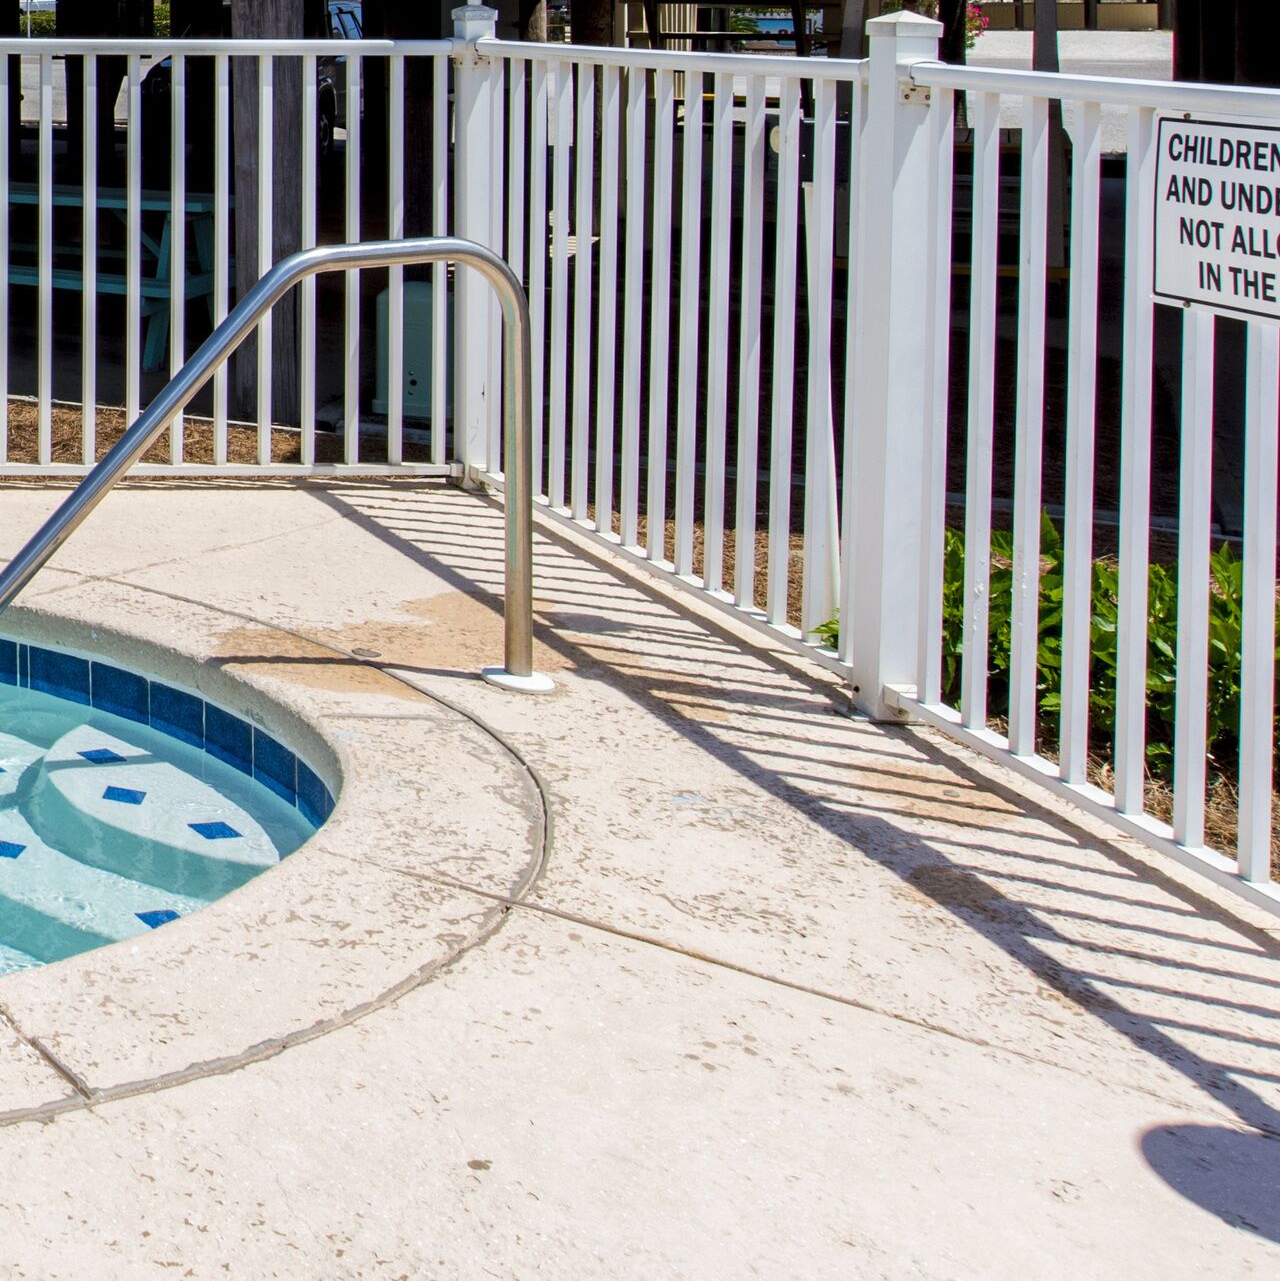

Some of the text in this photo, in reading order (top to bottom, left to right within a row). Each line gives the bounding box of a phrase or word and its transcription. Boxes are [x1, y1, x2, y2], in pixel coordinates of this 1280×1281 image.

[1166, 174, 1213, 207] AND
[1180, 217, 1280, 259] NOT ALL
[1199, 261, 1277, 303] IN THE
